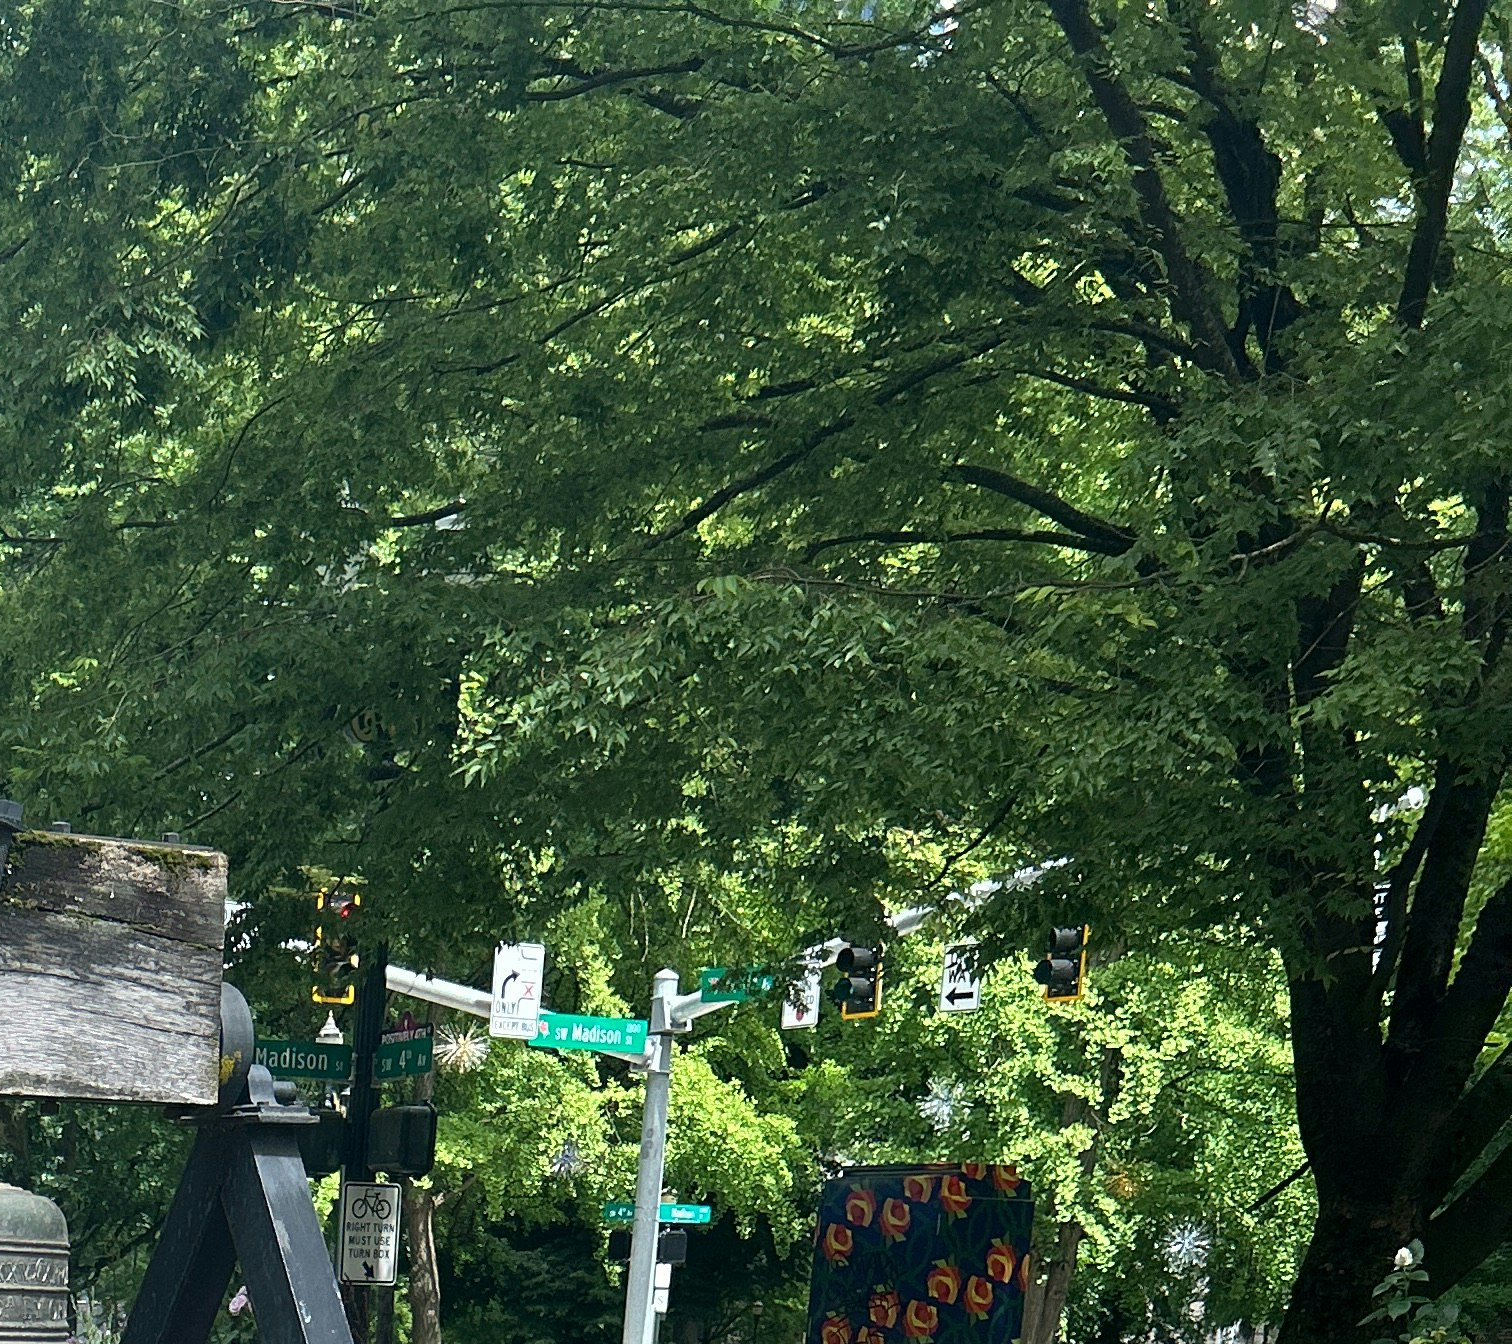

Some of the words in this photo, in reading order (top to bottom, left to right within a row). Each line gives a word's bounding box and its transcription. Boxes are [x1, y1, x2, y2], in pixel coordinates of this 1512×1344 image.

[496, 1000, 516, 1014] ONLY
[495, 1021, 518, 1031] EXCEPT
[522, 1023, 534, 1032] BUS
[555, 1027, 568, 1040] SW
[572, 1023, 622, 1045] Madison
[255, 1048, 328, 1071] Madison
[336, 1060, 344, 1072] St
[381, 1058, 393, 1073] SW
[346, 1222, 371, 1233] RIGHT
[373, 1222, 395, 1233] TURN
[348, 1235, 371, 1246] MUST
[374, 1236, 391, 1247] USE
[348, 1248, 371, 1259] TURN
[374, 1249, 390, 1259] BOX
